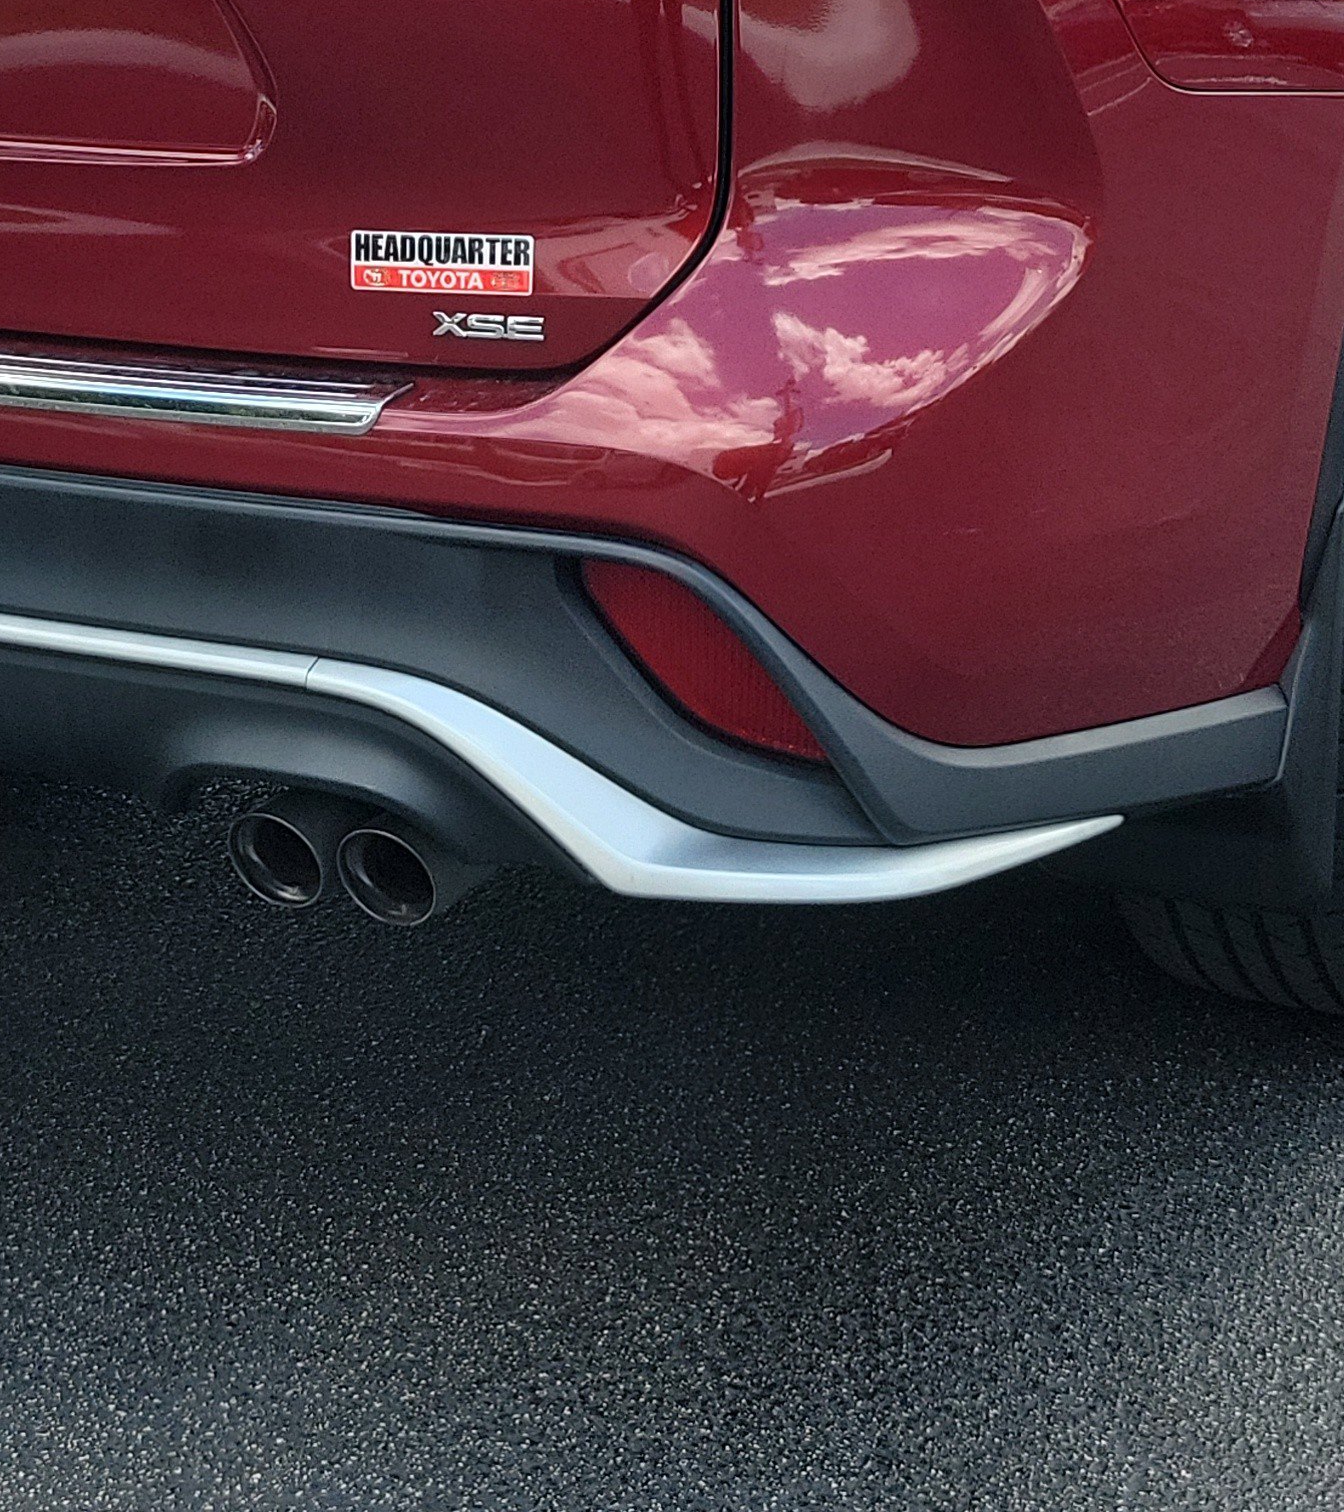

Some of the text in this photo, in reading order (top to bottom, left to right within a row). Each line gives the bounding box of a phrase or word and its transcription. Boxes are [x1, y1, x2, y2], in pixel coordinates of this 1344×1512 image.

[355, 233, 530, 266] HEADQUARTER
[398, 269, 484, 290] TOYOTA
[432, 311, 545, 341] XSE
